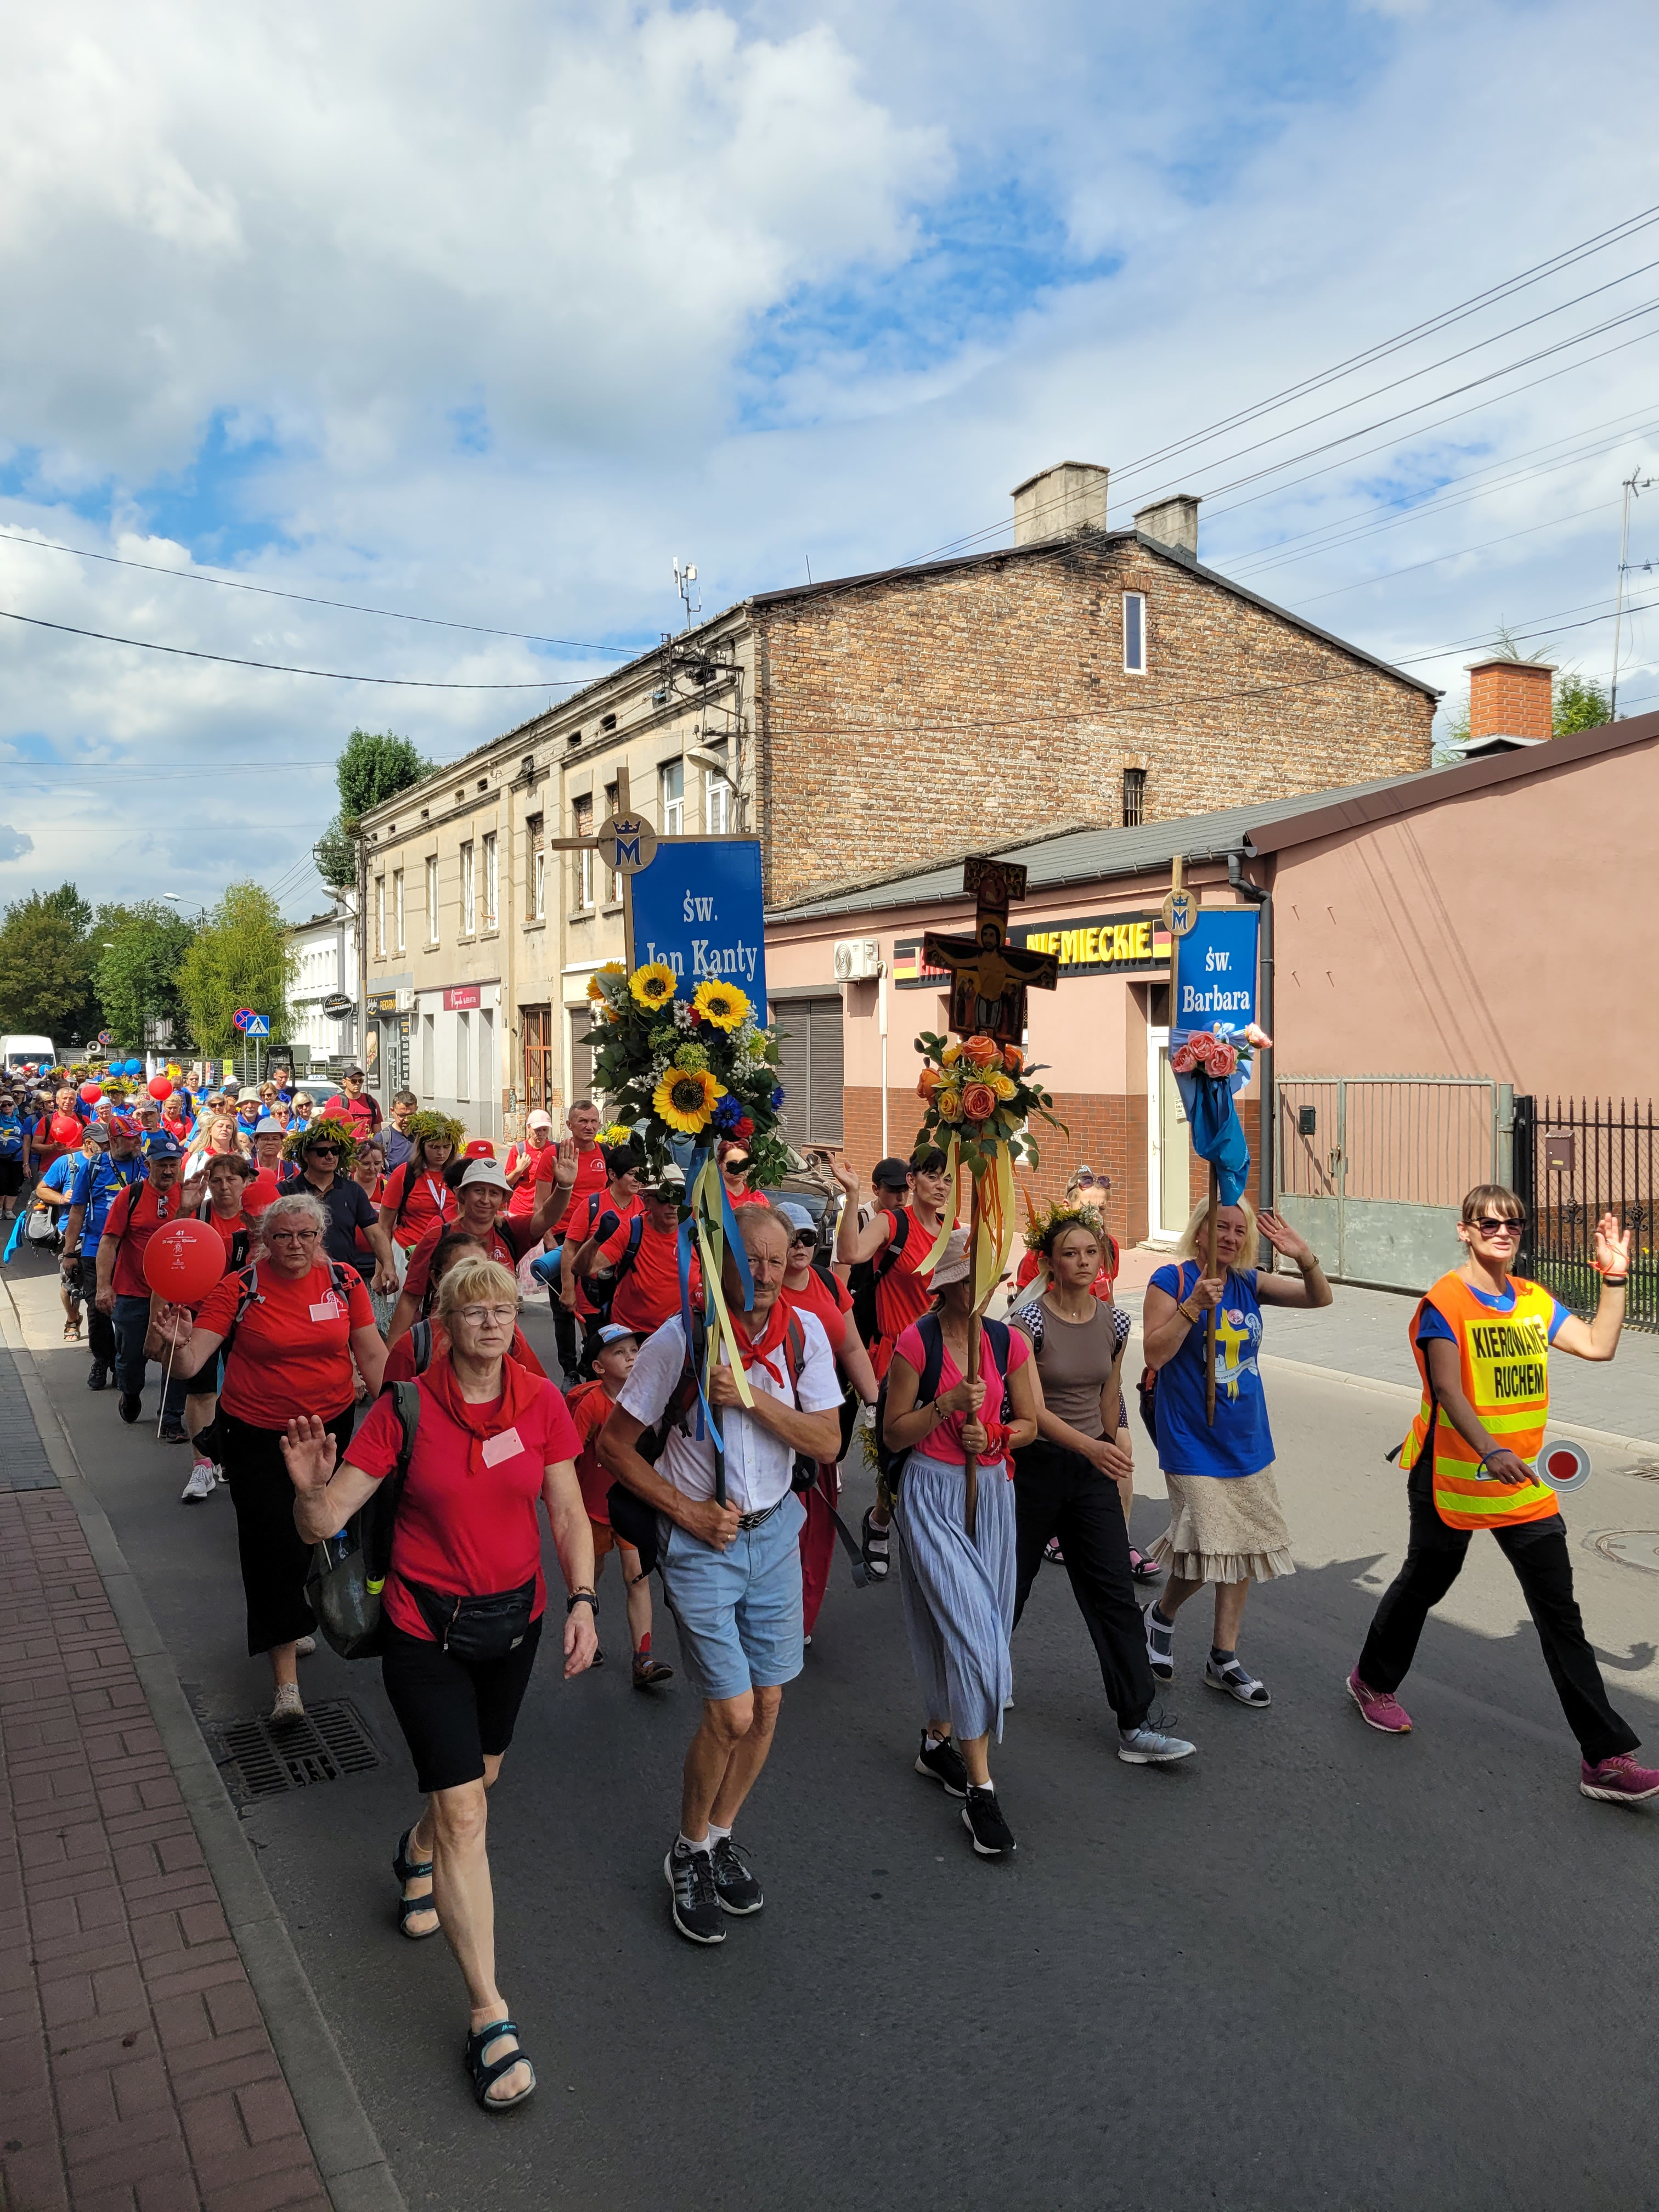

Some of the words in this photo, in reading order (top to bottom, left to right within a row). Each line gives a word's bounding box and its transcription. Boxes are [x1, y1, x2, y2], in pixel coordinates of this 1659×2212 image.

[614, 835, 644, 867] M
[683, 889, 718, 922] św.
[1170, 907, 1189, 931] M
[647, 942, 685, 976] Jan
[691, 939, 758, 982] Kanty
[1205, 946, 1232, 972] św.
[1182, 984, 1250, 1013] Barbara
[1493, 1363, 1544, 1398] RUCHEM
